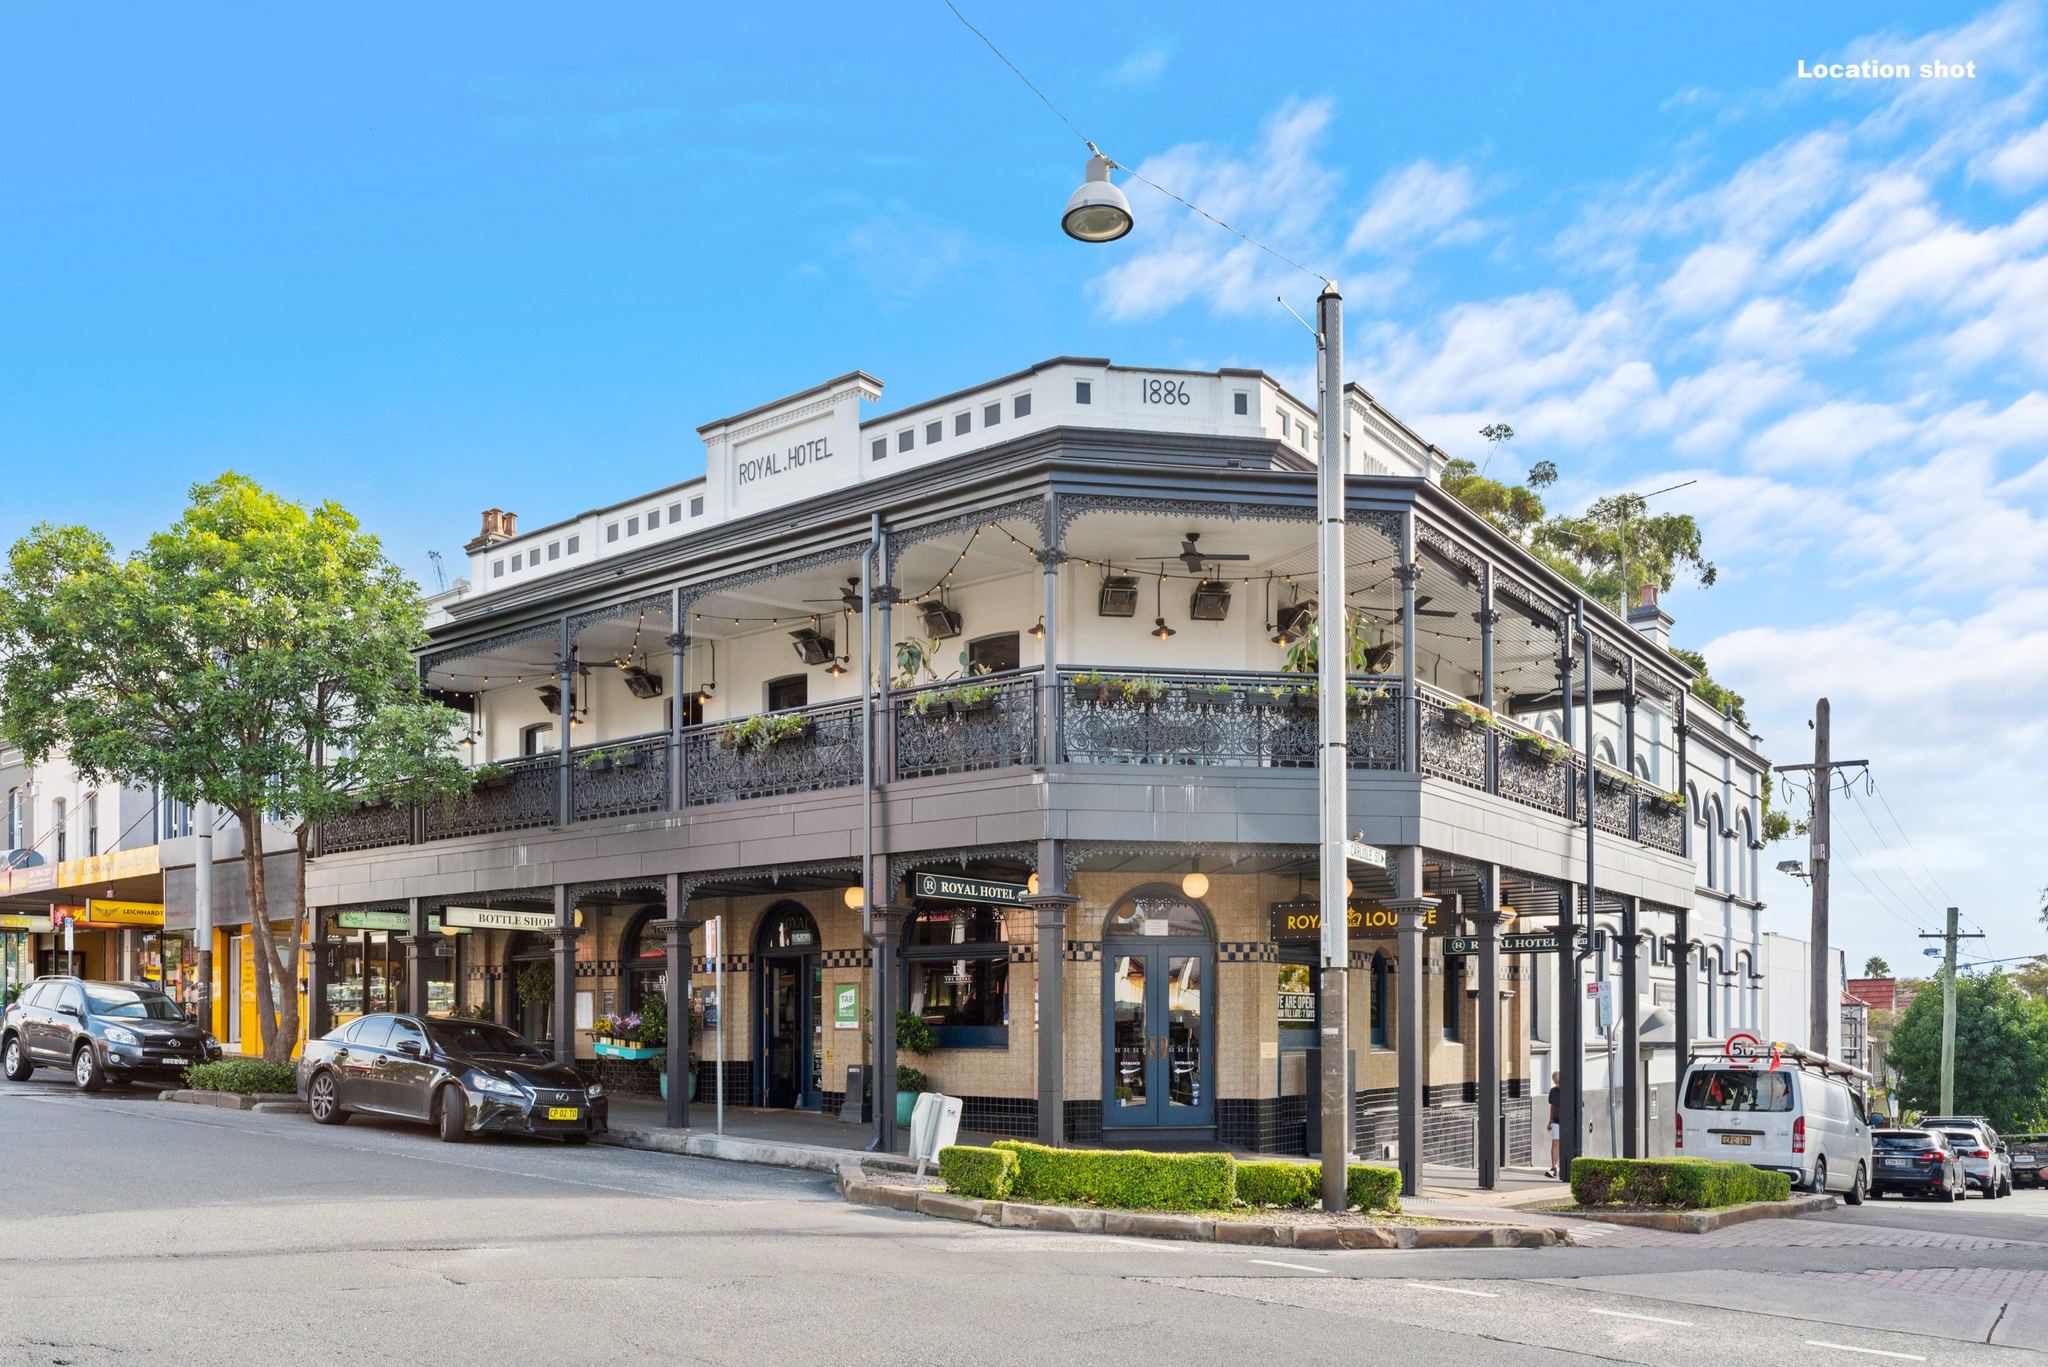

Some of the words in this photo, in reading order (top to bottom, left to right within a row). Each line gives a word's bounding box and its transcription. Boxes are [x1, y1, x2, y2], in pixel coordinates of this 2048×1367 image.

[1142, 378, 1191, 406] 1886
[941, 881, 978, 896] ROYAL
[980, 886, 1015, 900] HOTEL
[123, 908, 163, 917] LEICHHARDT
[1287, 914, 1321, 929] ROY
[1366, 909, 1437, 926] LOUE
[479, 913, 521, 926] BOTTLE
[523, 917, 553, 927] SHOP
[1471, 939, 1512, 950] RAL
[1515, 937, 1559, 949] HOTEL
[840, 994, 854, 1003] TAB
[1285, 995, 1297, 1009] ARE
